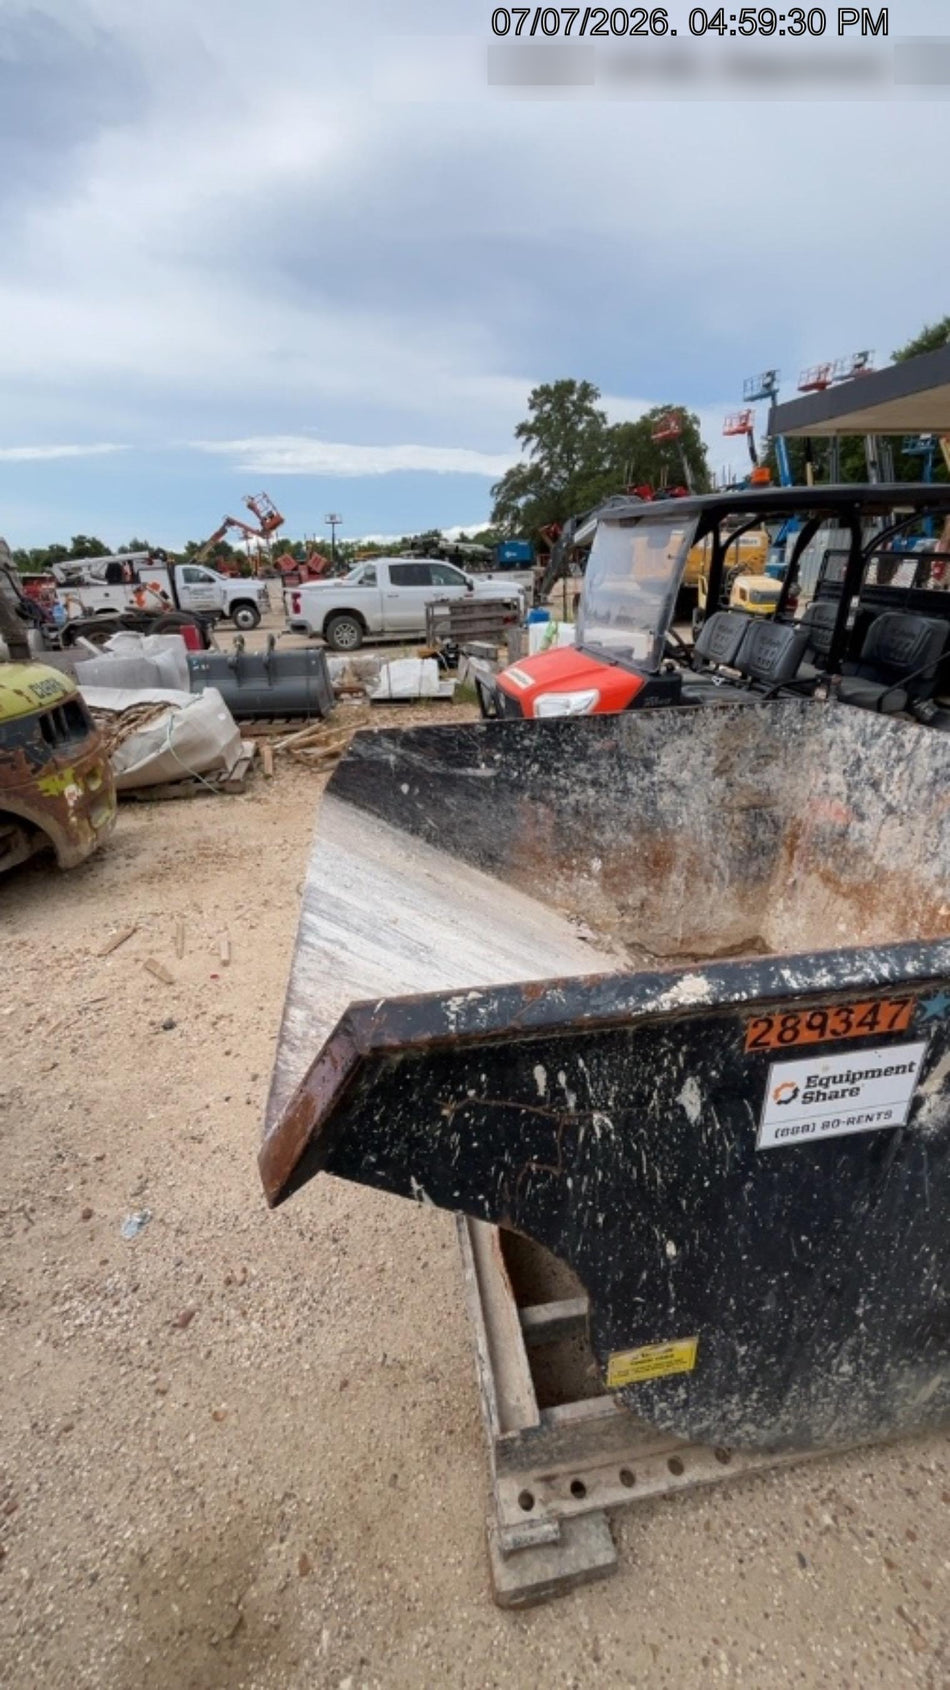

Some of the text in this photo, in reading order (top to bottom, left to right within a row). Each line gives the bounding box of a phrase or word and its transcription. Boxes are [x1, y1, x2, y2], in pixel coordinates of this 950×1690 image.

[748, 1000, 908, 1048] 289347
[805, 1060, 917, 1090] Equipment
[801, 1086, 861, 1105] Share
[774, 1110, 893, 1139] (888) 80-RENTS
